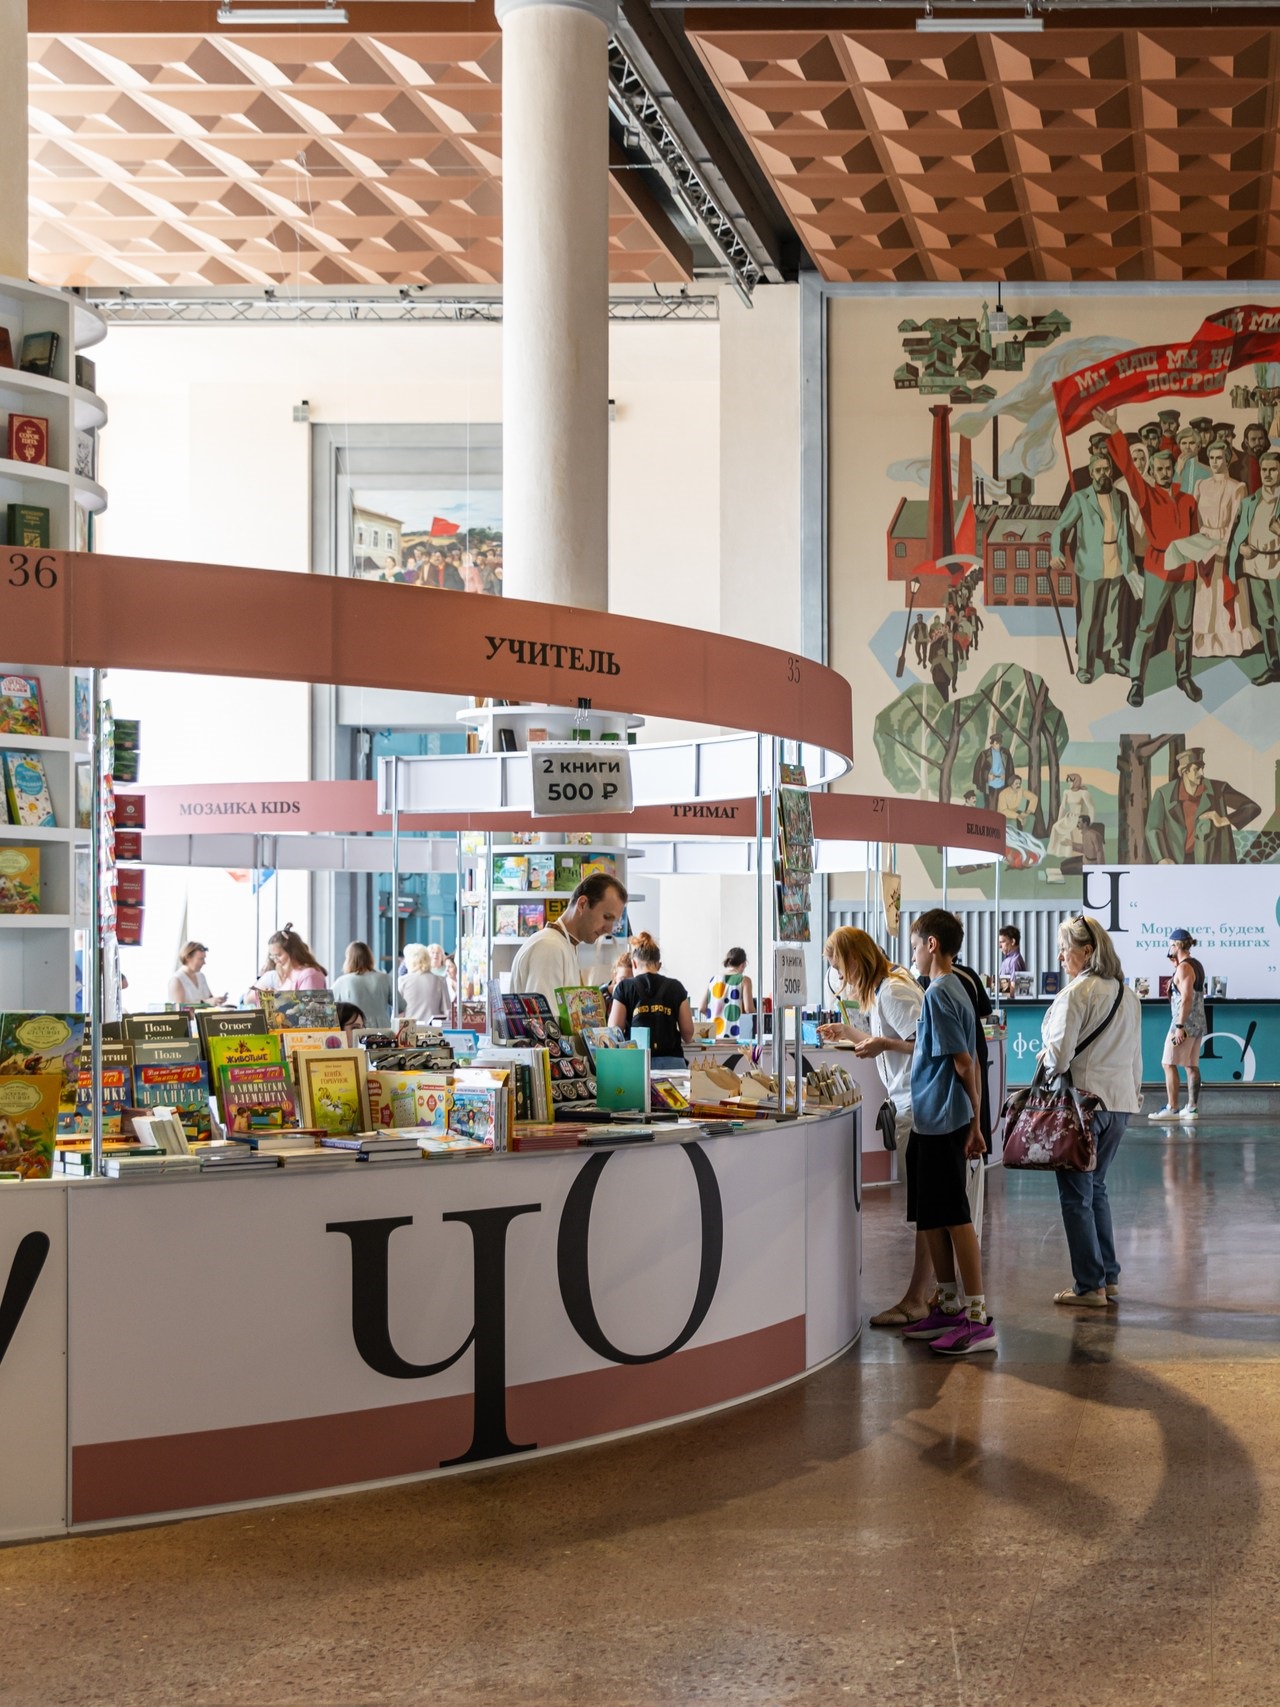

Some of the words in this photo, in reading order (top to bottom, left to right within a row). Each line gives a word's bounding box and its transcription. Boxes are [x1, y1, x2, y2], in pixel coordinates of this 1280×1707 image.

[1115, 352, 1159, 378] НАШ
[8, 553, 57, 588] 36
[485, 636, 621, 676] УЧИТЕЛЬ
[788, 656, 800, 684] 35
[543, 759, 554, 774] 2
[560, 762, 620, 773] книги
[548, 783, 593, 801] 500
[602, 783, 618, 800] ₽
[180, 802, 257, 816] МОЗАИКА
[261, 801, 300, 814] KIDS
[670, 805, 739, 819] ТРИМАГ
[872, 799, 885, 812] 27
[1220, 923, 1265, 937] будем
[1220, 940, 1270, 948] книгах
[144, 1023, 172, 1033] Поль
[219, 1021, 253, 1031] Огюст
[1013, 1032, 1046, 1059] фе
[154, 1050, 182, 1060] Поль
